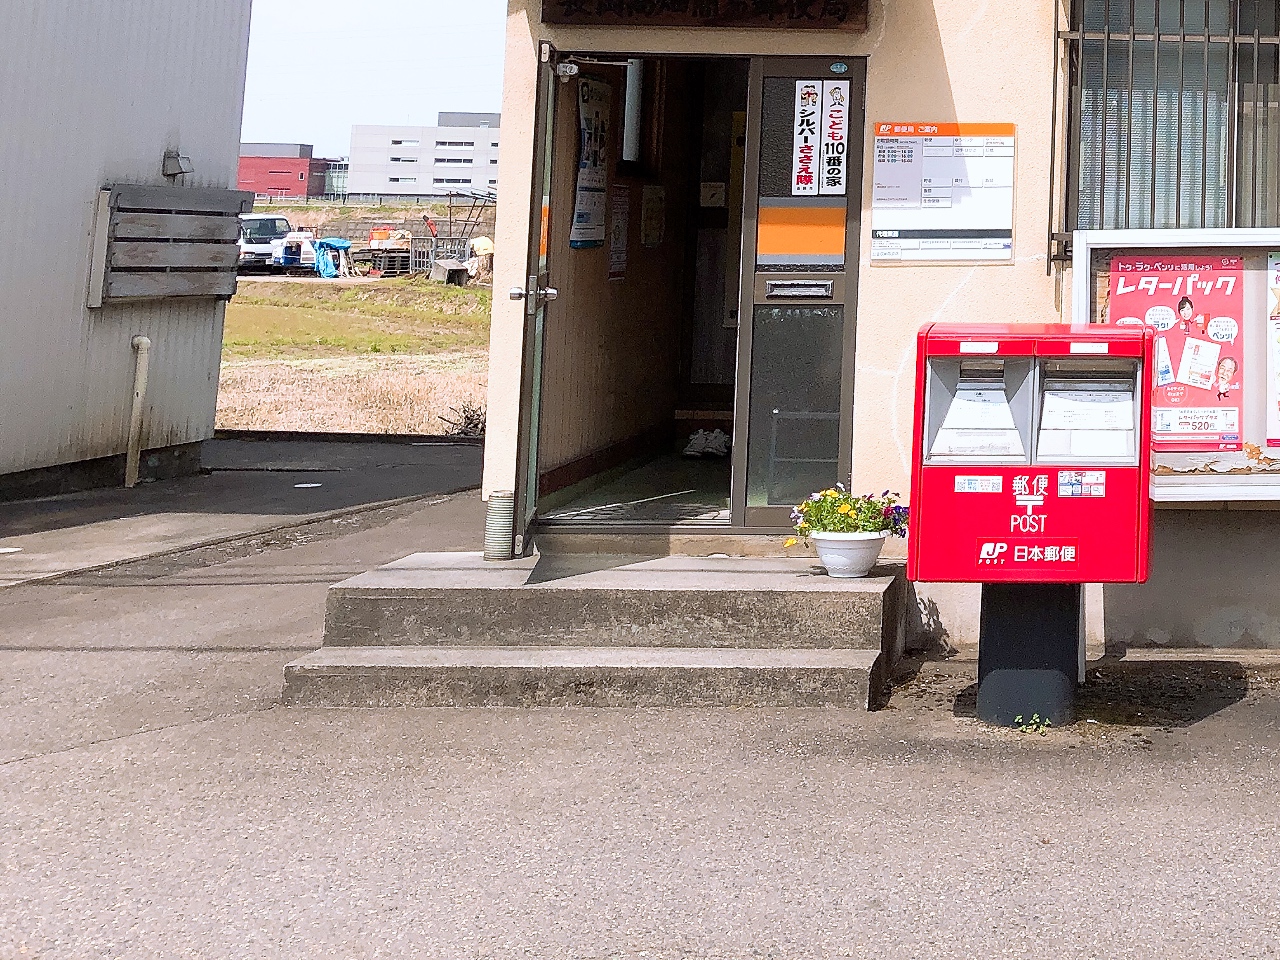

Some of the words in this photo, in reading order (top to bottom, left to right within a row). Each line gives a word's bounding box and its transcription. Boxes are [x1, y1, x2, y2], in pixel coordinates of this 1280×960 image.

[796, 109, 815, 185] シルバーささえ隊
[824, 109, 845, 186] こども110番の家
[1115, 273, 1238, 296] レターパック
[1012, 474, 1049, 496] 郵便
[1010, 514, 1048, 533] POST
[1014, 545, 1076, 562] 日本郵便
